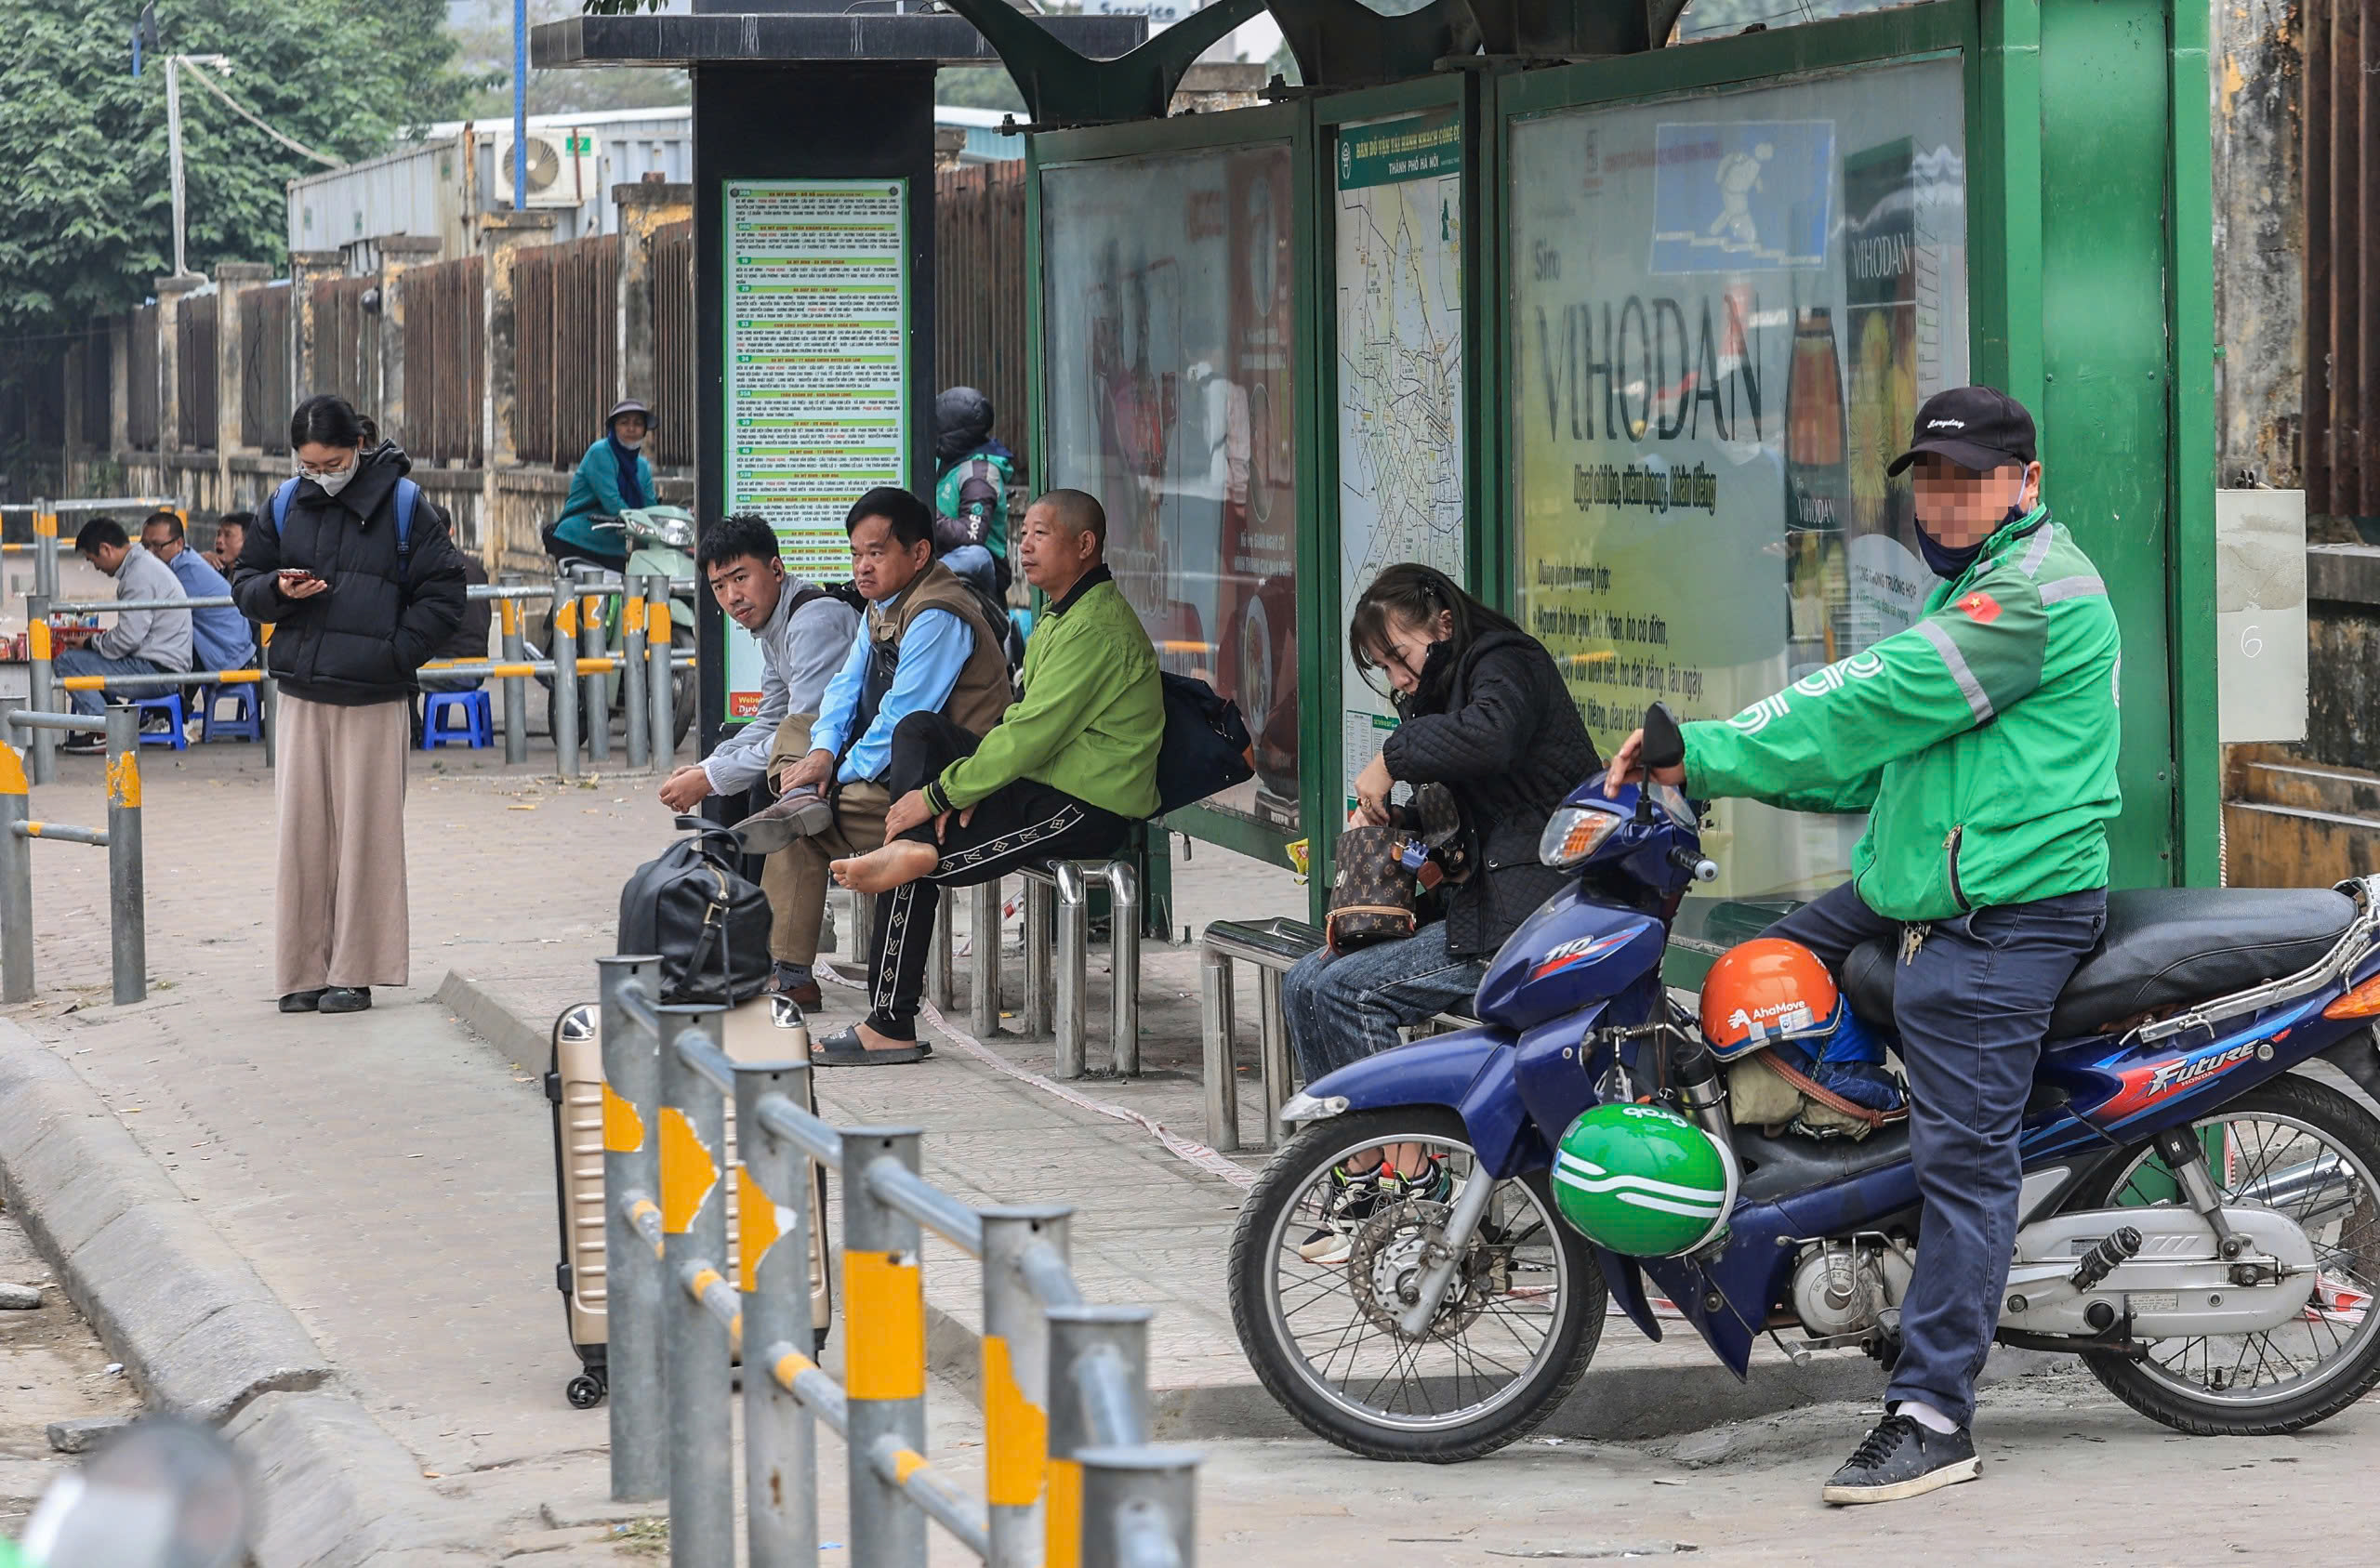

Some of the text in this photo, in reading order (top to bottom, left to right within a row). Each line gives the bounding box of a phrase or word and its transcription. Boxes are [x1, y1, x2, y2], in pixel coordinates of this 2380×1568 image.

[1852, 233, 1910, 280] VIHODAN
[1535, 294, 1762, 442] VIHODAN
[1796, 495, 1835, 523] VIHODAN
[1567, 607, 1577, 635] ho
[1627, 612, 1636, 642] ho
[1637, 613, 1646, 643] có
[2241, 626, 2262, 657] 6
[1620, 656, 1629, 686] ho
[1631, 657, 1643, 688] dai
[1543, 935, 1593, 965] 110
[1753, 999, 1805, 1020] AhaMove
[2181, 1072, 2215, 1087] HONDA
[1622, 1107, 1688, 1128] Grab
